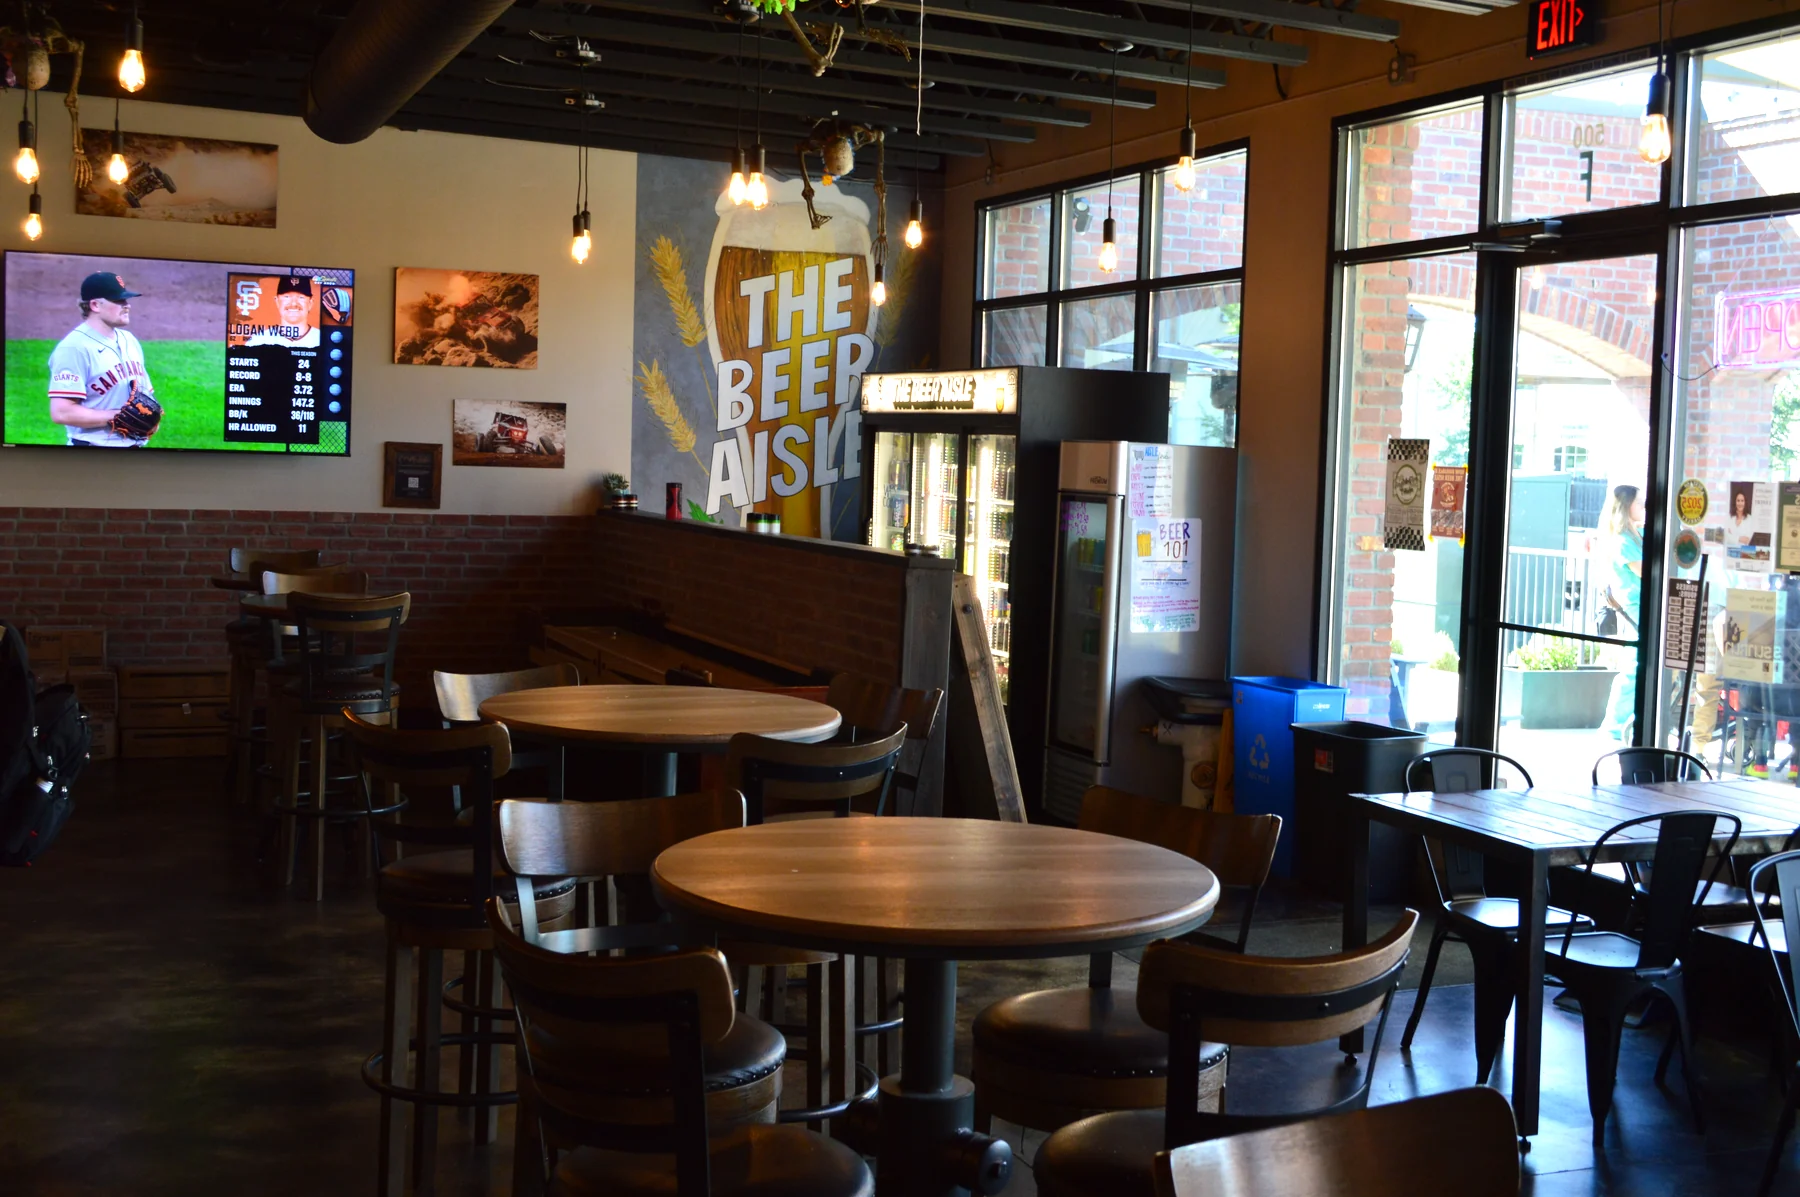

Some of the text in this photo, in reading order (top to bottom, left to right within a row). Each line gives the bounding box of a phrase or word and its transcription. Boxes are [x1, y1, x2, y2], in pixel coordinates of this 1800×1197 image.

[1536, 0, 1575, 50] EXIT
[739, 257, 854, 348] THE
[229, 323, 300, 339] LOGAN WEBB
[229, 358, 310, 369] STARTS 24
[54, 374, 79, 382] GIANTS
[91, 369, 118, 395] SAN
[229, 371, 312, 382] RECORD 8-8
[716, 333, 875, 432] BEER
[229, 384, 313, 395] ERA 3.72
[229, 397, 315, 408] INNINGS 147.2
[228, 409, 248, 418] BB/K
[228, 423, 307, 433] HR ALLOWED 11
[705, 409, 863, 516] AISLE
[1159, 522, 1190, 541] BEER
[1163, 540, 1189, 559] 101
